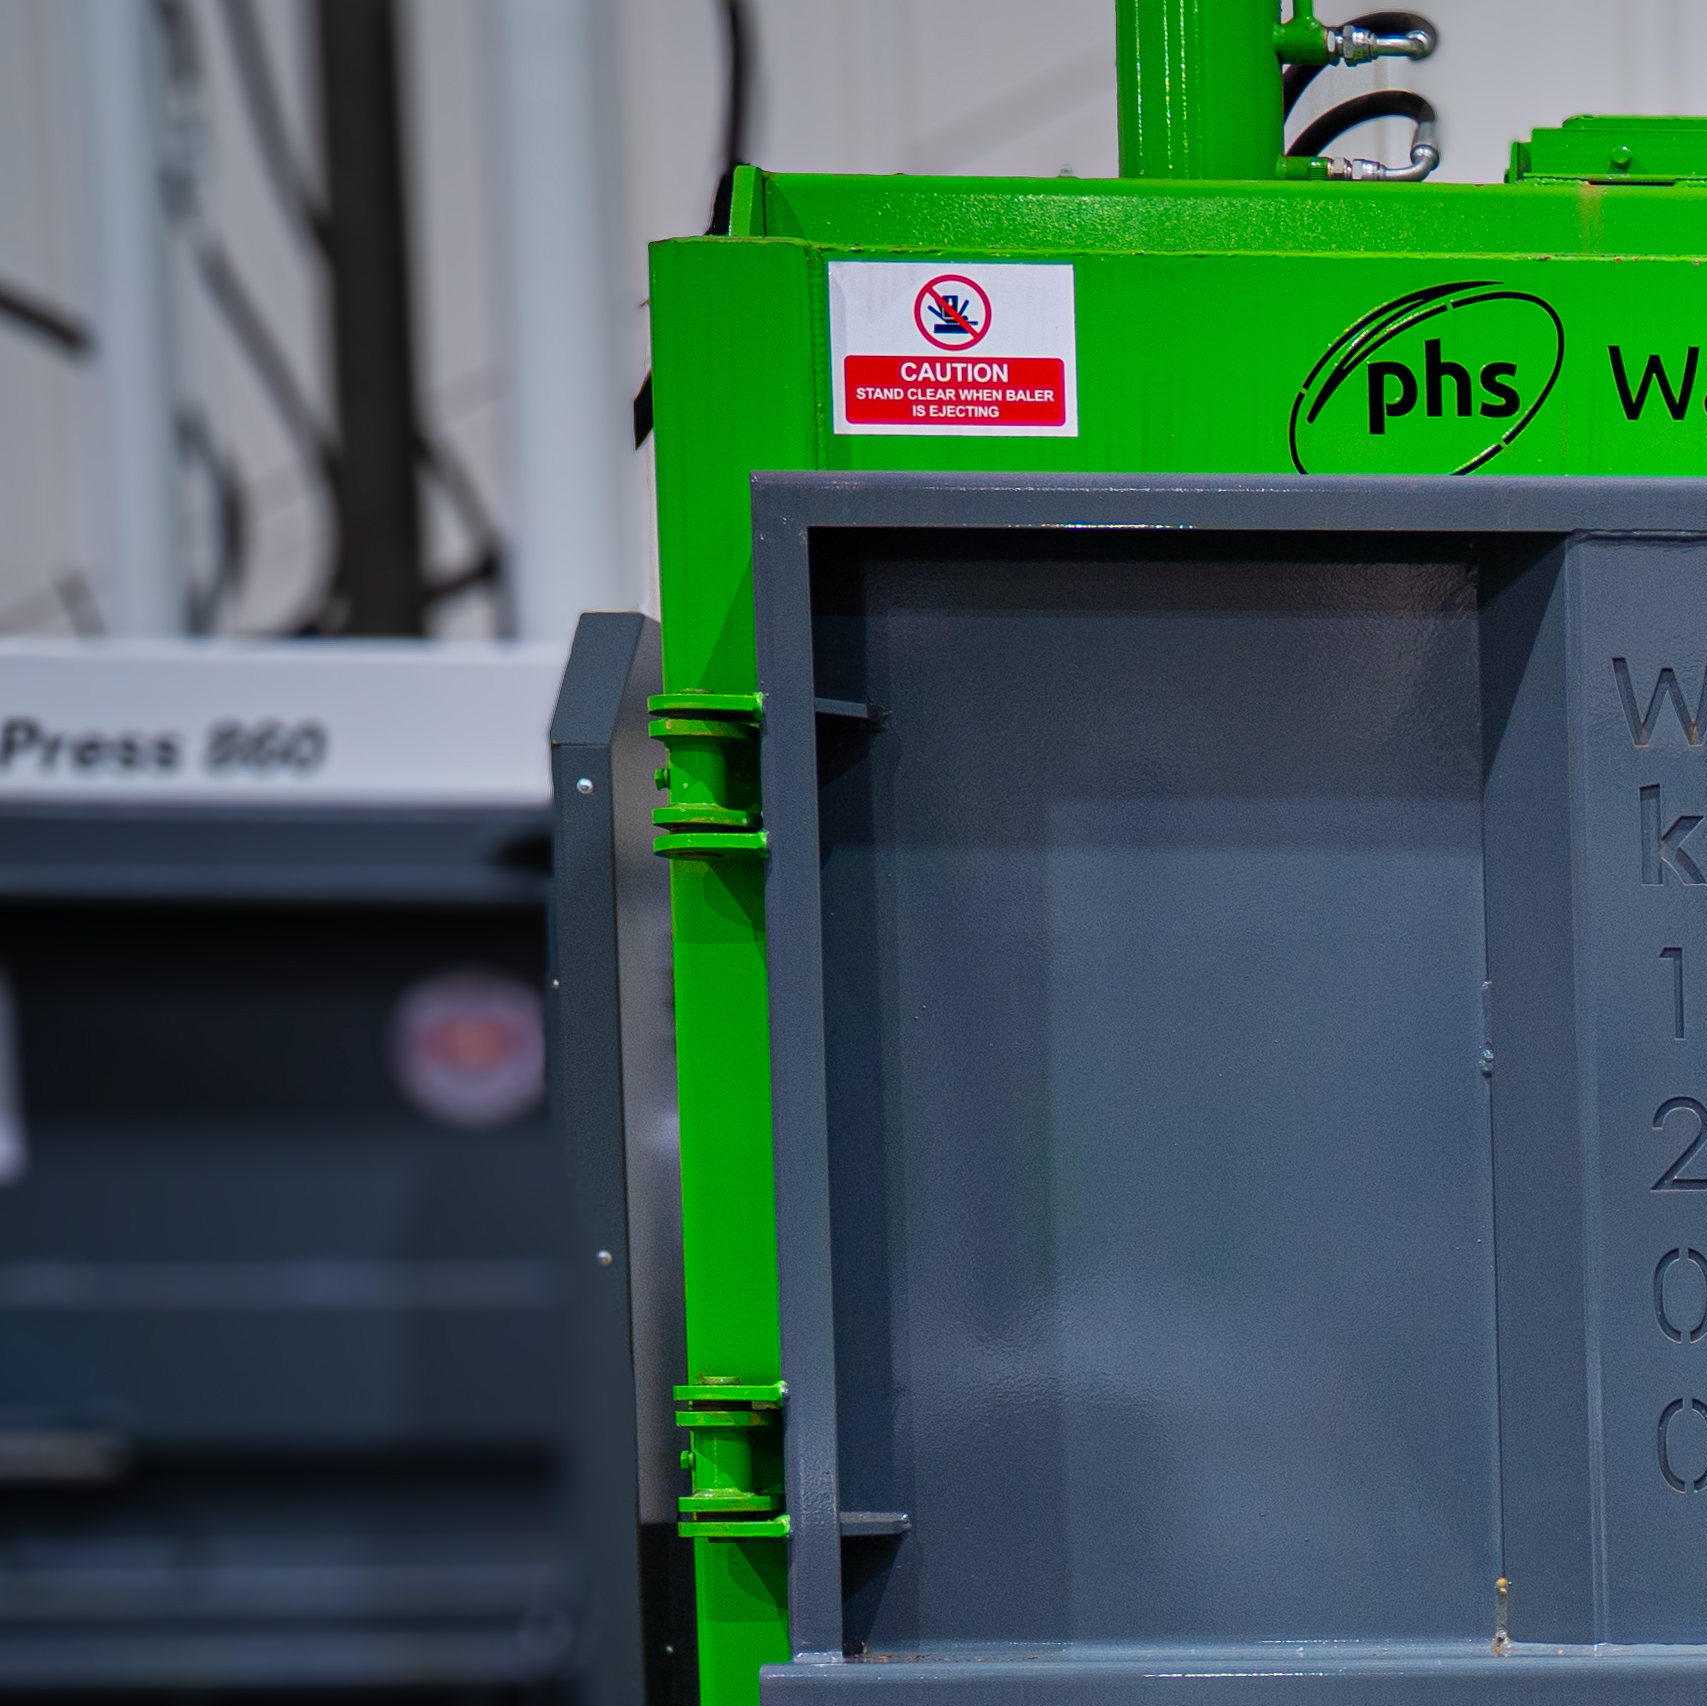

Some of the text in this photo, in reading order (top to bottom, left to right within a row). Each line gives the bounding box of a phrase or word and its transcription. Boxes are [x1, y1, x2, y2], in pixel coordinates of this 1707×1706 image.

[900, 362, 1009, 382] CAUTION
[856, 387, 1054, 402] STAND CLEAR WHEN BALER
[1367, 338, 1521, 434] phs
[912, 405, 1000, 418] IS EJECTING
[0, 716, 182, 777] Press
